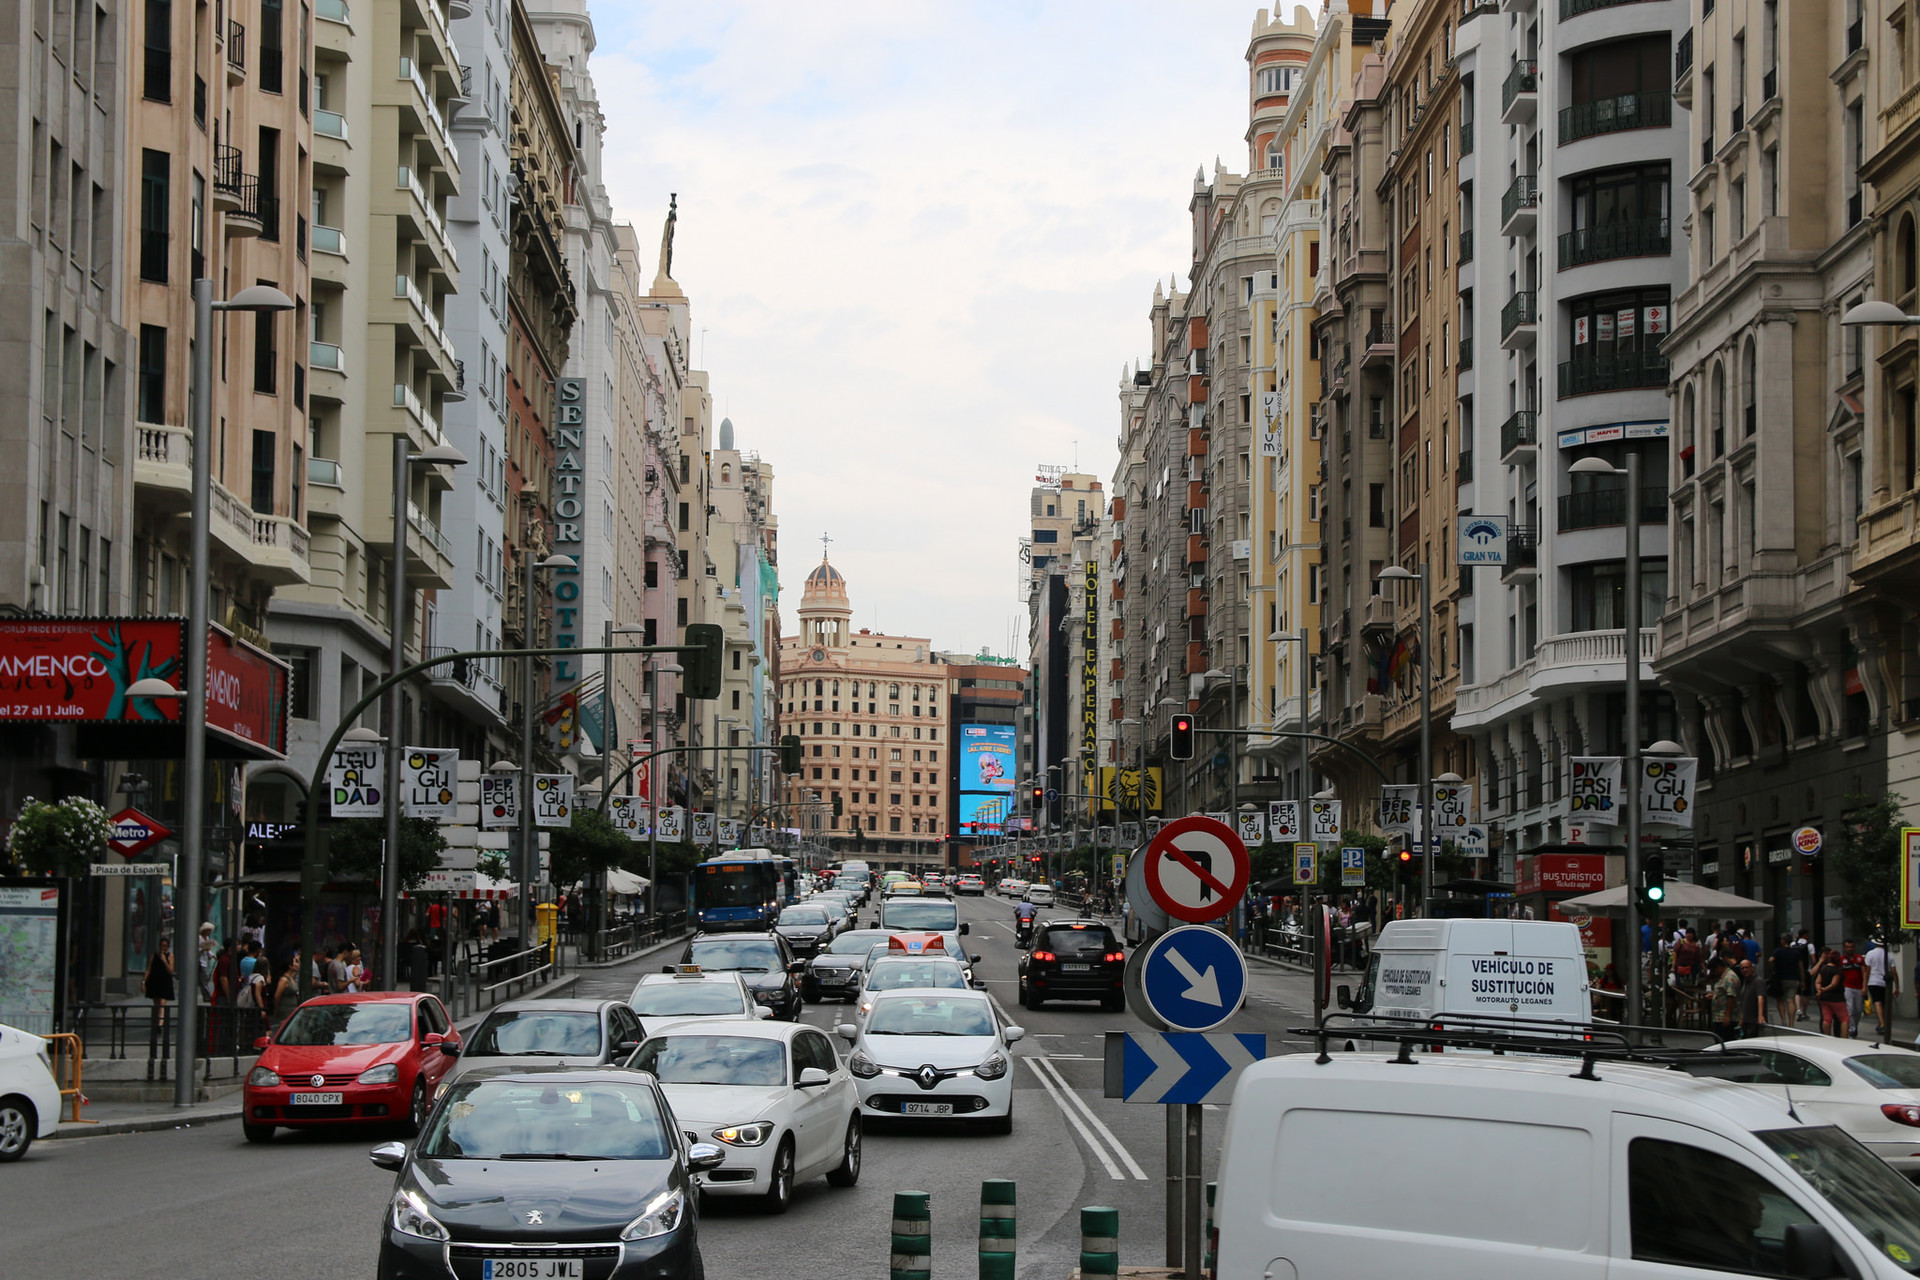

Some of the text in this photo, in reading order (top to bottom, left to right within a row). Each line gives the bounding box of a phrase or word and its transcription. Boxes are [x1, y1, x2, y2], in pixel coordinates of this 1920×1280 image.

[556, 382, 582, 541] SENATOR
[1463, 520, 1482, 536] CENTRO
[1463, 551, 1501, 561] GRAN VIA
[1086, 562, 1097, 639] HOTEL
[14, 706, 28, 715] 27
[32, 705, 42, 715] al
[46, 706, 51, 715] 1
[55, 705, 84, 715] Julio
[334, 752, 376, 769] IGU
[409, 752, 440, 770] OR
[1573, 762, 1604, 778] DIV
[1646, 762, 1677, 778] OR
[342, 769, 372, 787] AL
[418, 770, 448, 788] GU
[536, 778, 559, 791] OR
[483, 779, 513, 791] DER
[1654, 778, 1685, 796] GU
[334, 788, 380, 805] DAD
[412, 788, 453, 805] LLO
[484, 792, 514, 805] ECH
[543, 791, 566, 805] GU
[1436, 788, 1457, 801] OR
[539, 804, 568, 817] LLO
[1313, 803, 1330, 813] OR
[1442, 801, 1464, 814] GU
[1647, 795, 1688, 813] LLO
[493, 805, 515, 817] OS
[1318, 814, 1336, 824] GU
[1438, 814, 1466, 827] LLO
[112, 827, 146, 838] Metro
[1315, 823, 1338, 834] LLO
[1571, 828, 1581, 841] P
[1797, 833, 1818, 842] BURGER
[1798, 838, 1820, 848] KING
[96, 866, 163, 876] Plaza de España
[1543, 870, 1603, 882] BUS TURÍSTICO
[1471, 957, 1553, 975] VEHÍCULO DE
[1471, 977, 1554, 995] SUSTITUCIÓN
[1476, 996, 1519, 1004] MOTORAUTO
[296, 1095, 340, 1103] 8040 CPX
[908, 1104, 950, 1113] 9714 JBP
[494, 1262, 578, 1278] 2805 JWL
